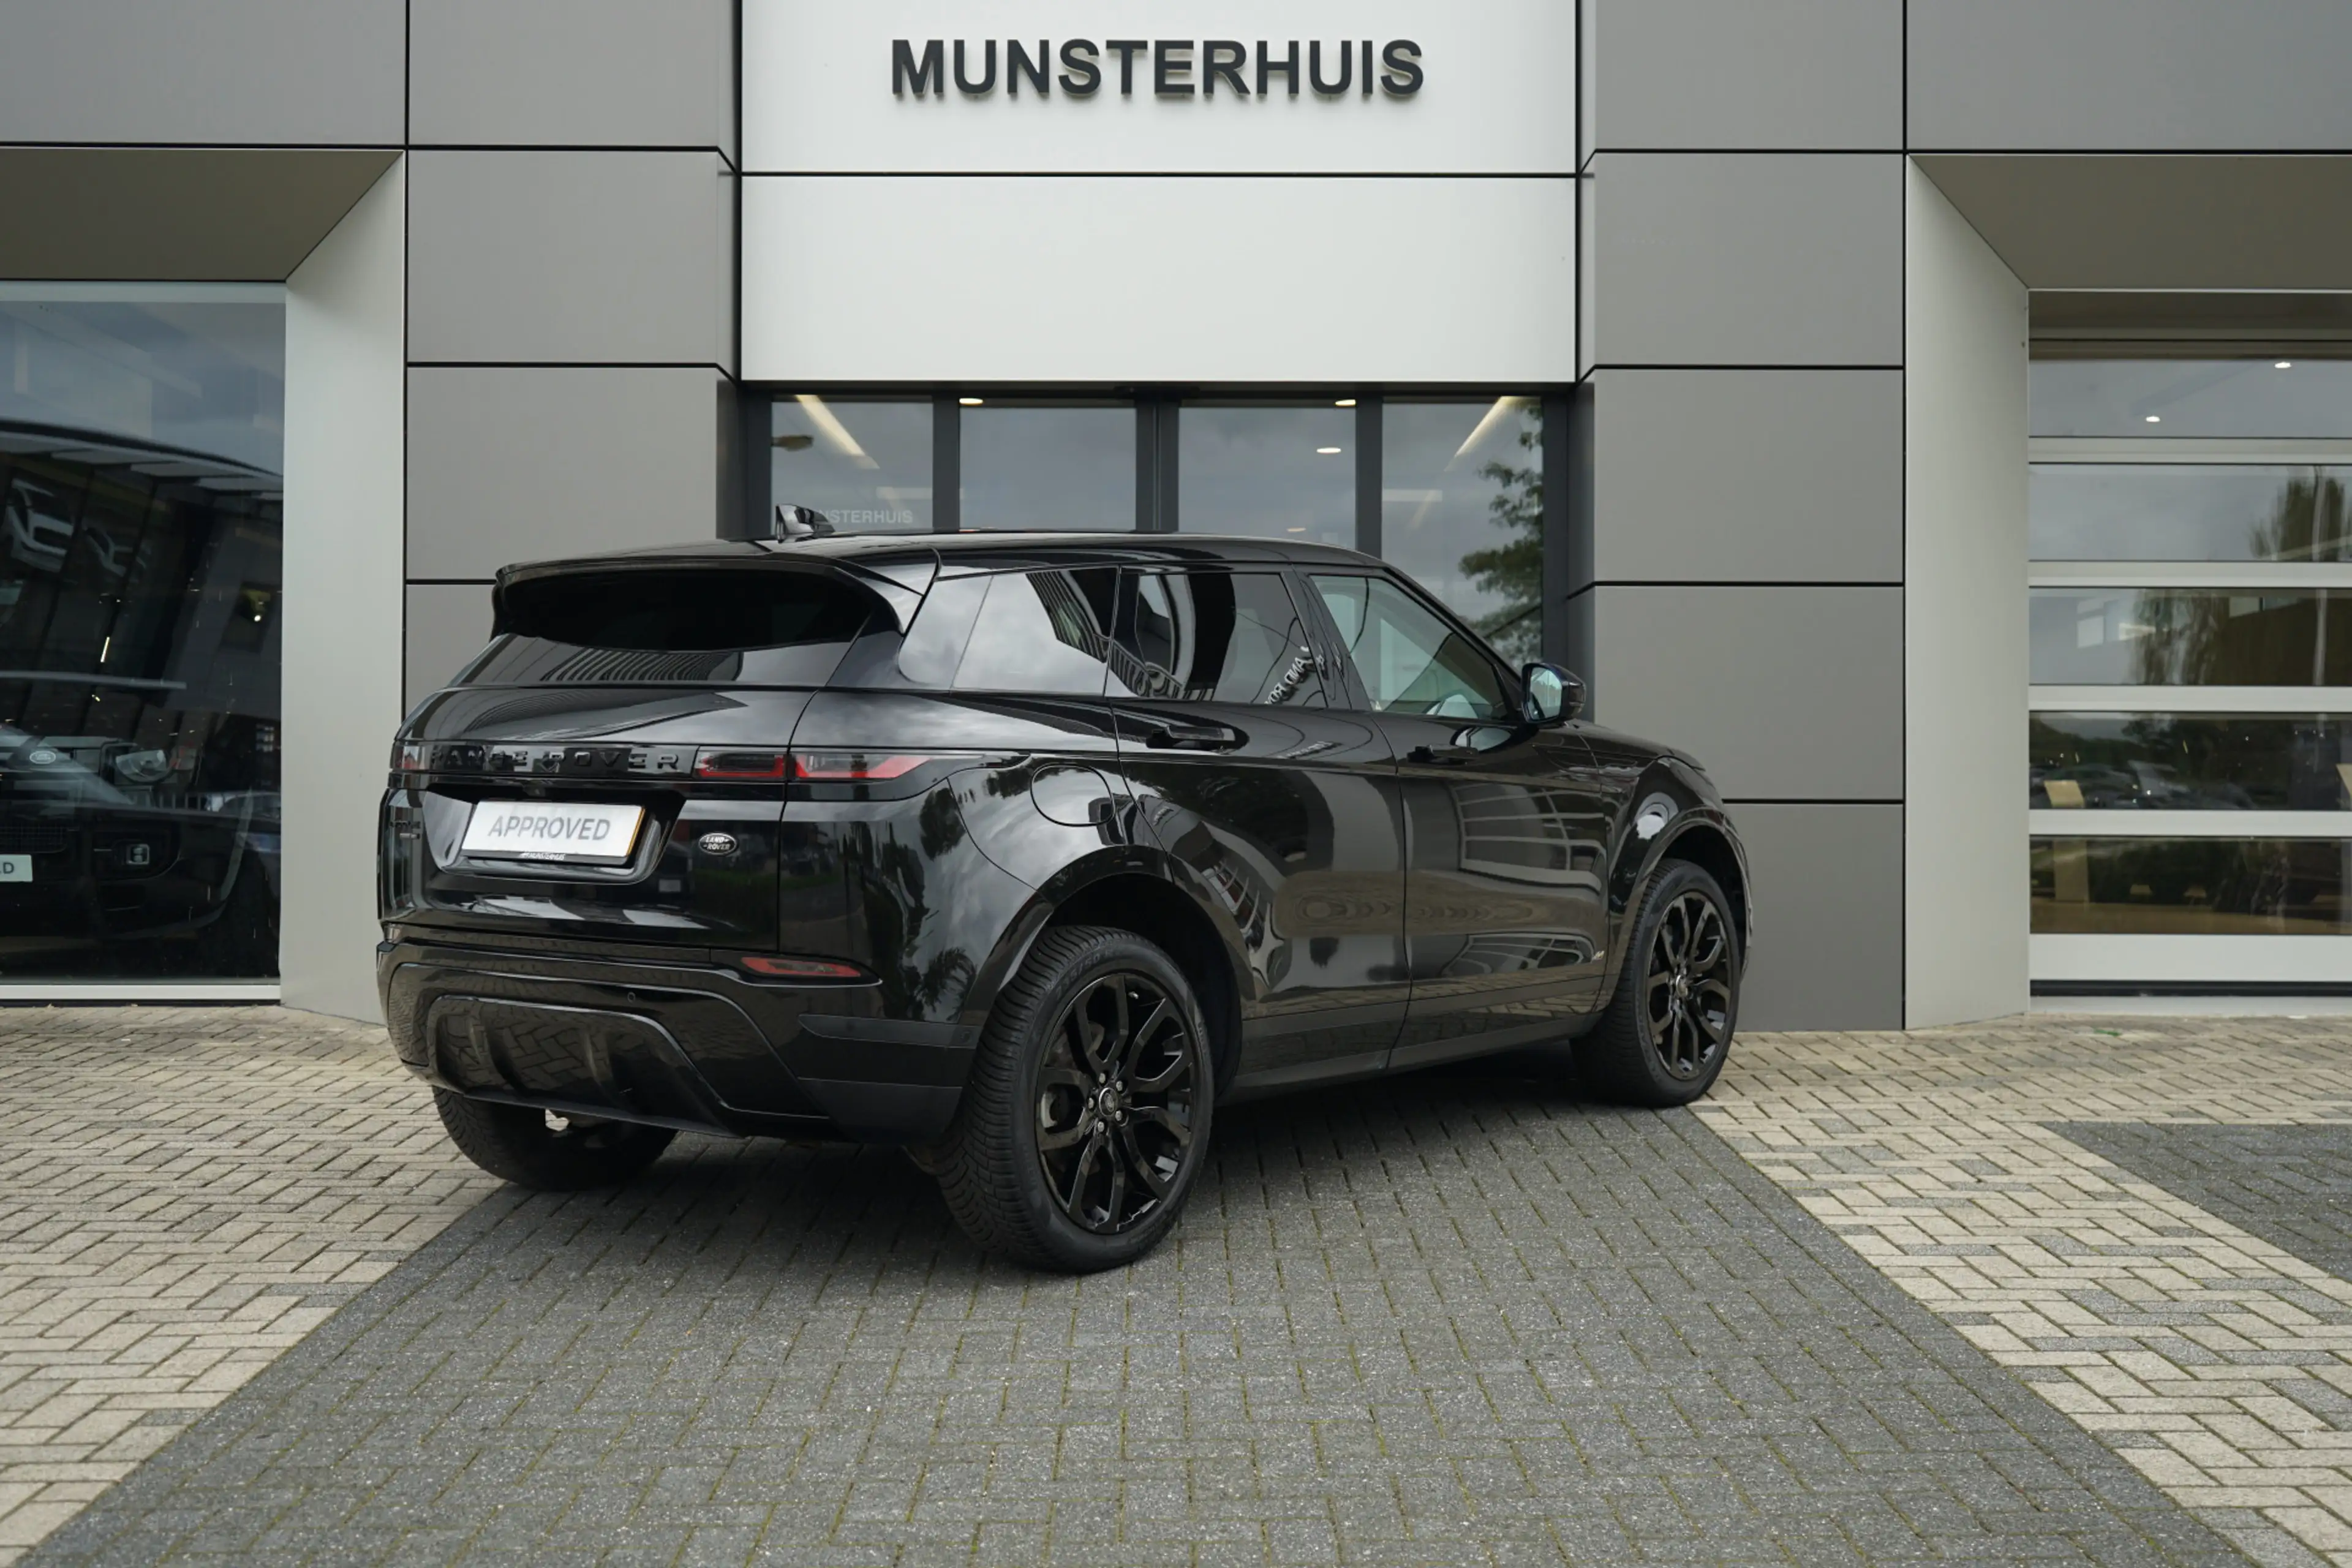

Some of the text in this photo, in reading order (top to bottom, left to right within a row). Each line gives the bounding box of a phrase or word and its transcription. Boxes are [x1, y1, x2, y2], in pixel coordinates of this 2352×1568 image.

[891, 39, 1424, 96] MUNSTERHUIS
[818, 509, 913, 524] NSTERHUIS
[547, 751, 679, 769] ROVER
[488, 815, 611, 841] APPROVED
